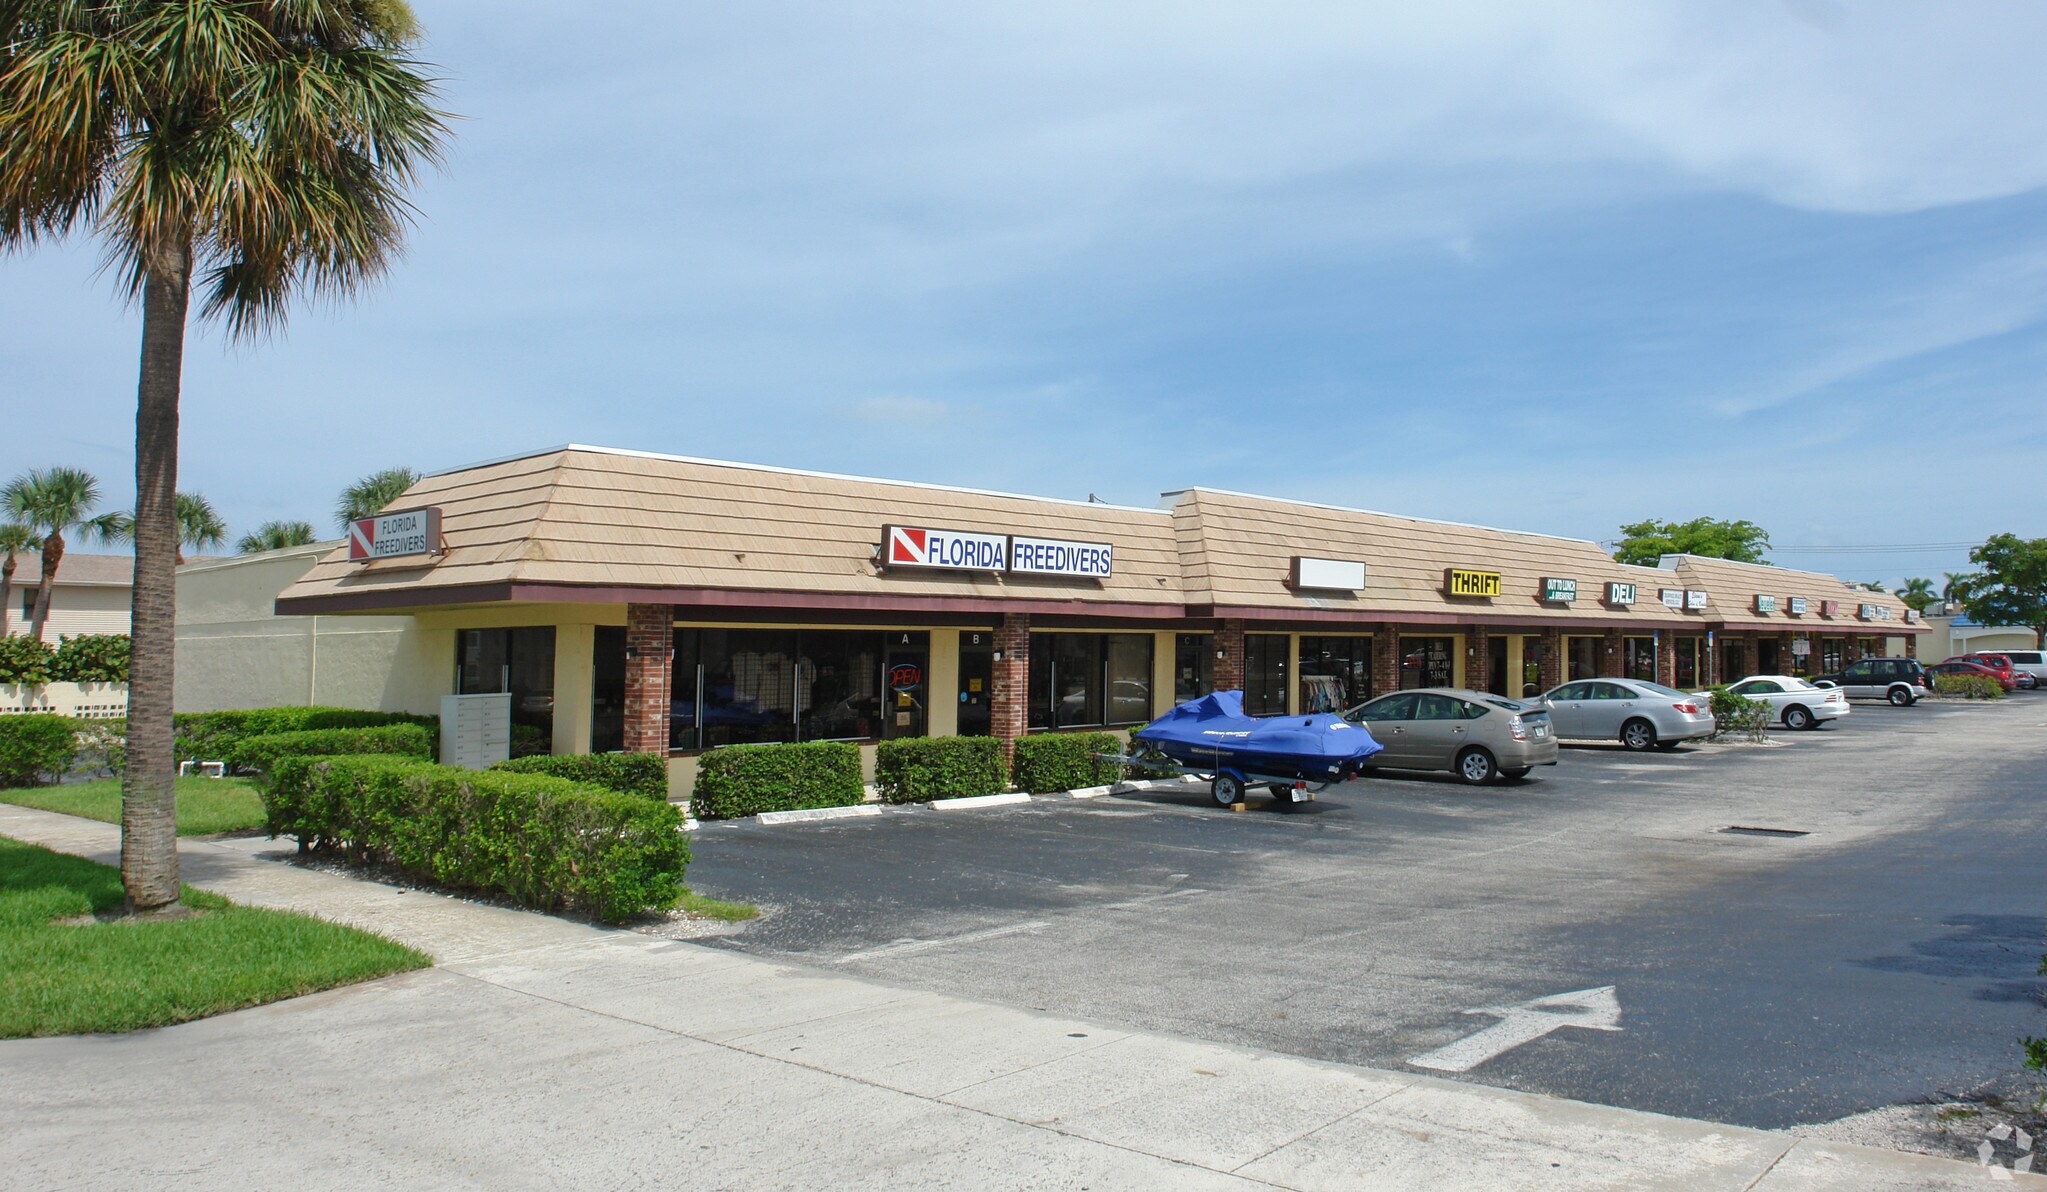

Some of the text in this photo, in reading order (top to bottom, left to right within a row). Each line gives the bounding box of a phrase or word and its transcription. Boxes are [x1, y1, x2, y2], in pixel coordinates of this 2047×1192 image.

[382, 516, 417, 535] FLORIDA
[375, 535, 425, 555] FREEDIVERS
[929, 537, 1111, 574] FLORIDA FREEDIVERS
[1453, 572, 1500, 595] THRIFT
[1547, 578, 1557, 591] OUT
[1562, 579, 1576, 592] LUNCH
[1612, 583, 1635, 604] DELI
[901, 633, 910, 644] A
[972, 634, 980, 644] B
[888, 668, 921, 687] OPEN
